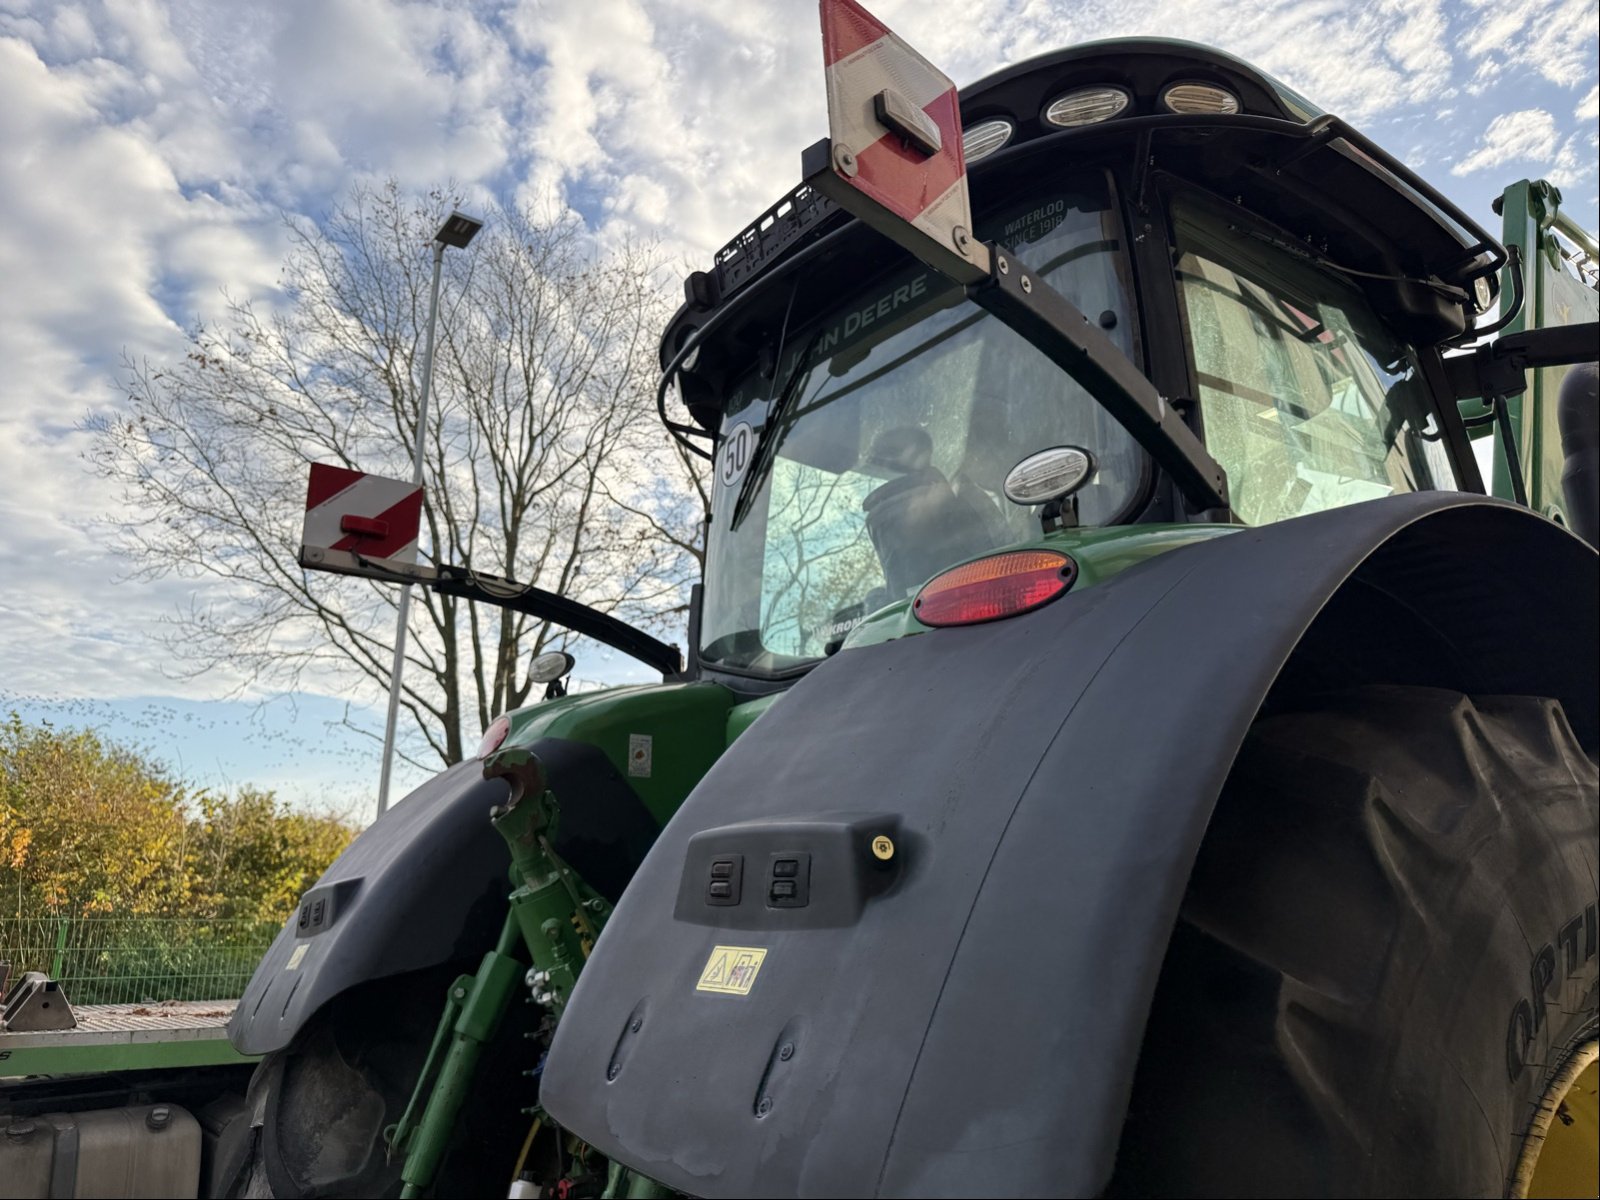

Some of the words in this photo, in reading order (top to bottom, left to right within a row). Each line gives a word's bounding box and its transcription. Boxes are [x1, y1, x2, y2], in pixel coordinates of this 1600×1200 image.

[1004, 199, 1064, 236] WATERLOO
[1004, 225, 1037, 250] SINCE
[1040, 214, 1063, 234] 1918
[844, 273, 928, 338] DEERE
[725, 428, 747, 480] 50
